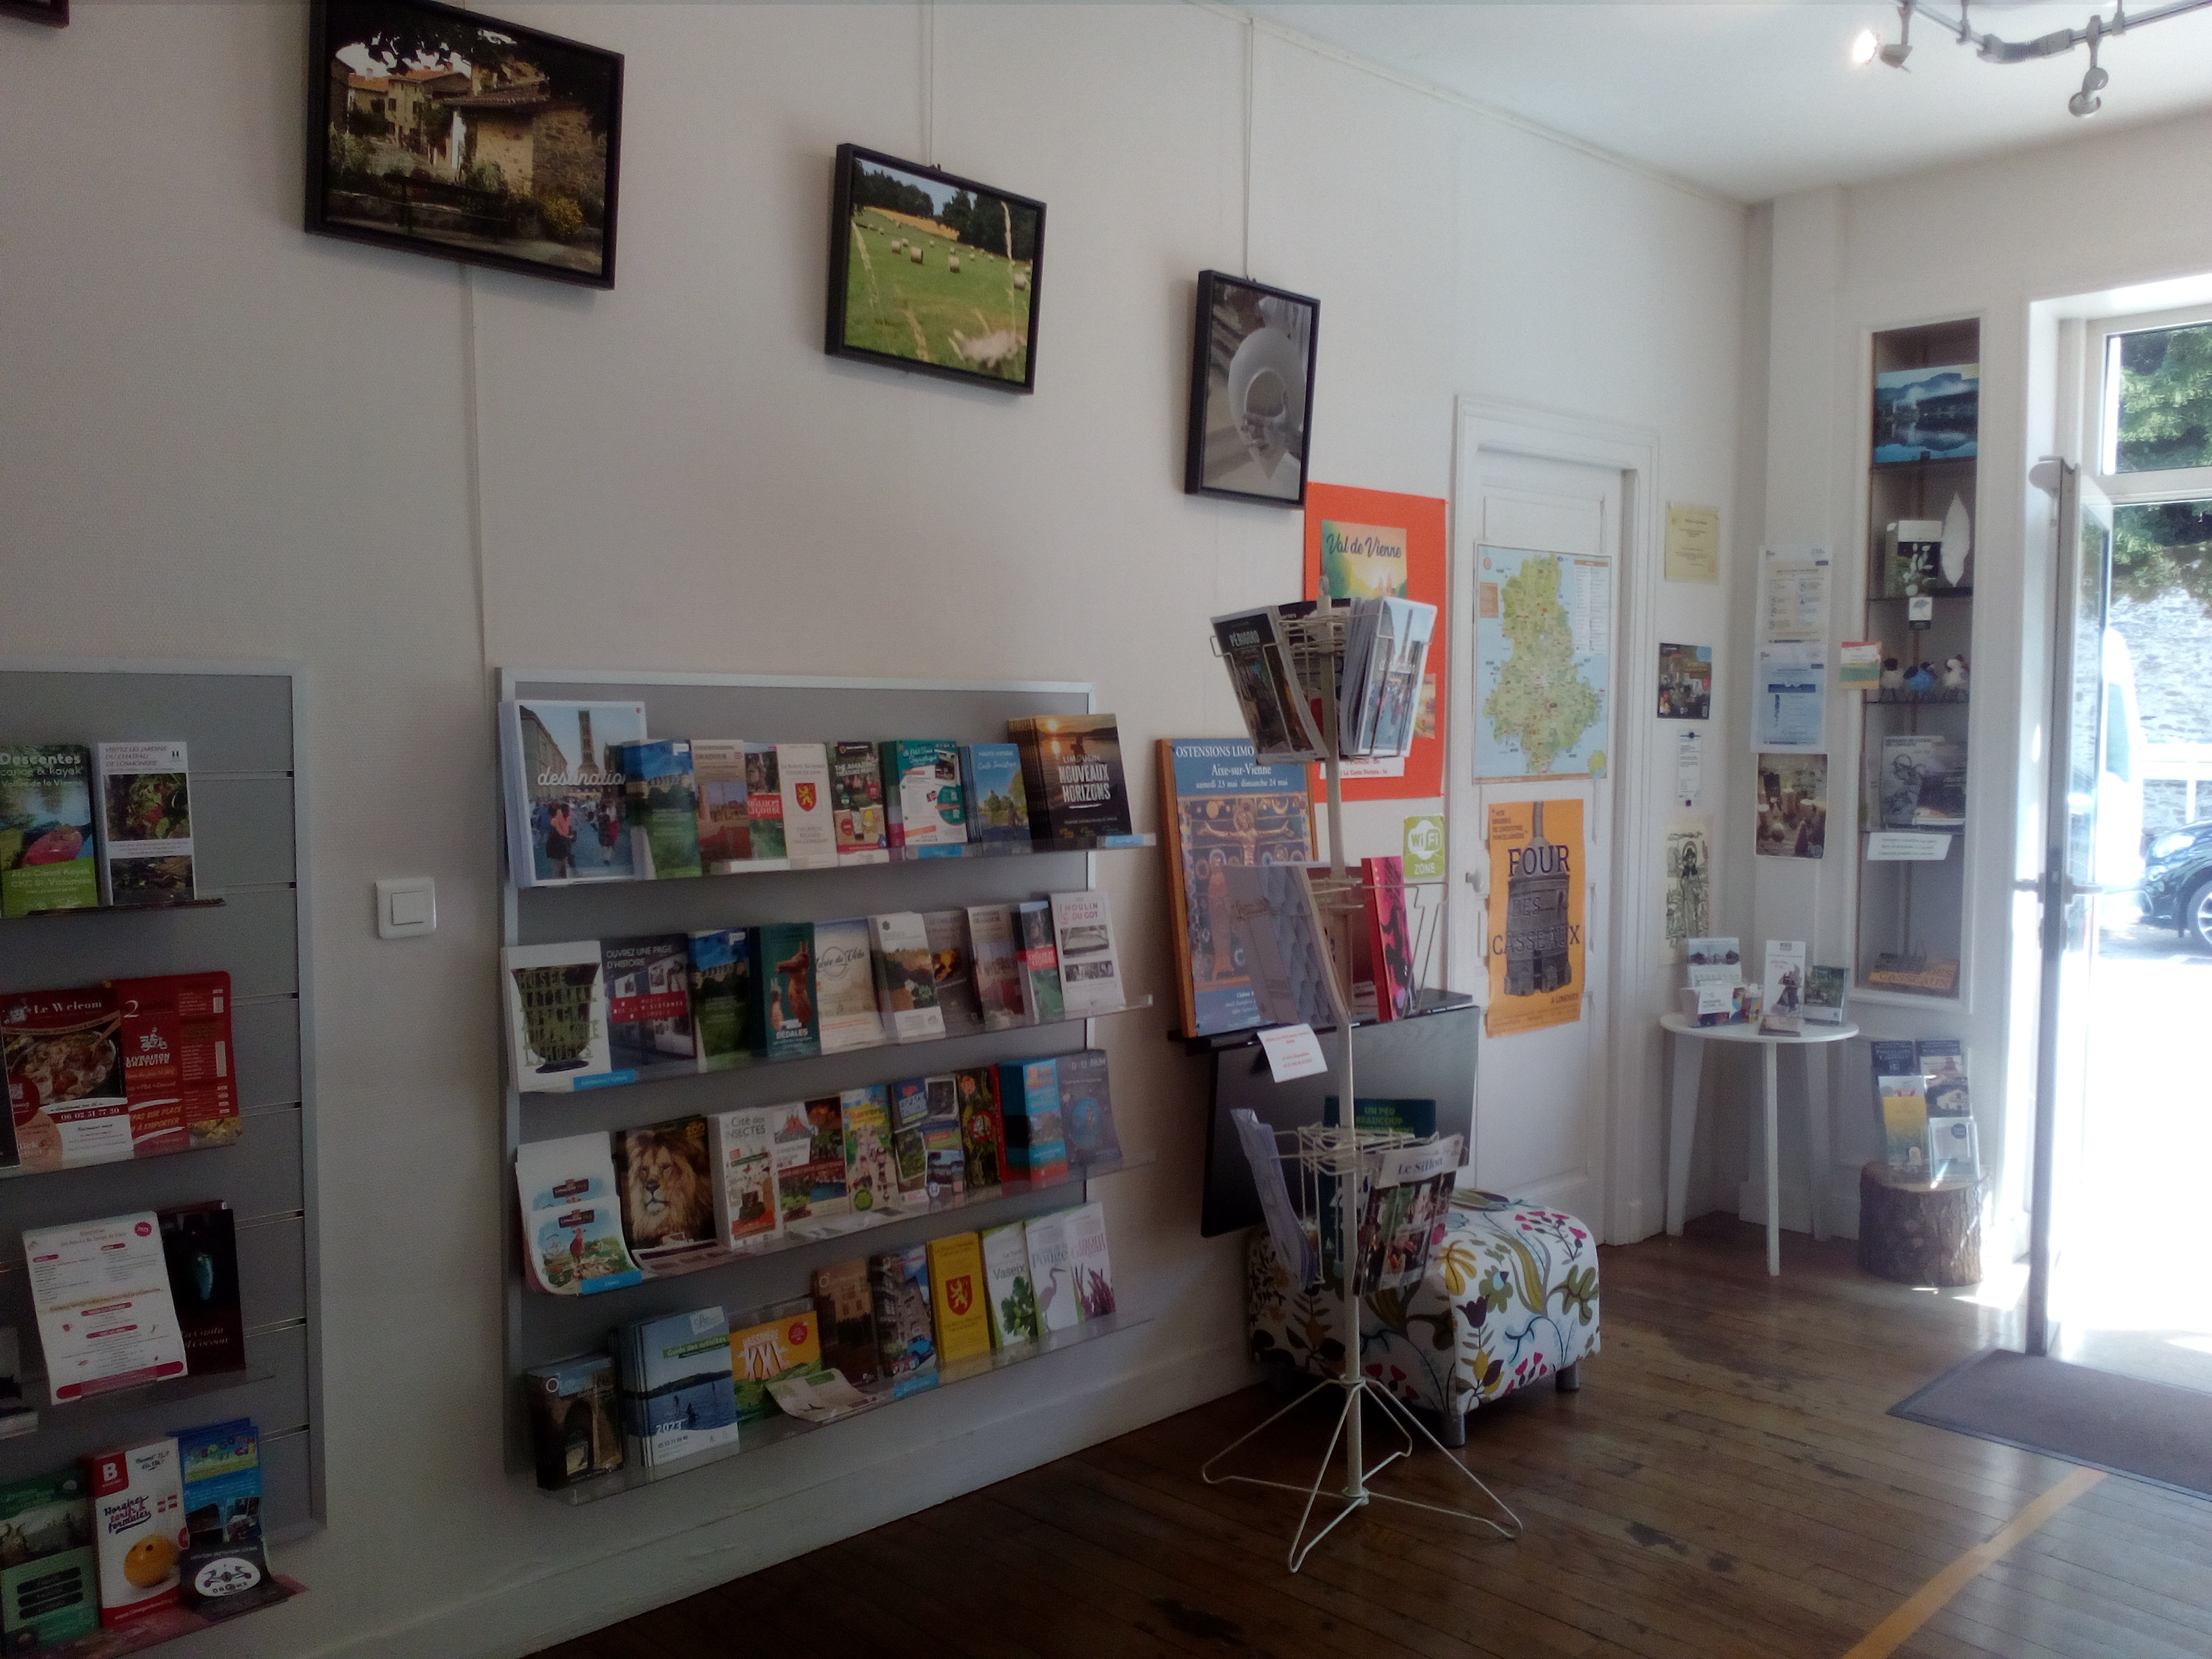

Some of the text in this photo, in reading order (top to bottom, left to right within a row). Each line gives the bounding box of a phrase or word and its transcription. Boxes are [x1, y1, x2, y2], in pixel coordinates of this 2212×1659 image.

[1326, 533, 1402, 558] Val de Vienne
[1176, 746, 1230, 758] OSTENSIONS
[0, 753, 81, 766] Descentes
[48, 766, 84, 780] kayak
[1057, 764, 1109, 784] NOUVEAUX
[1211, 763, 1271, 776] Aixe-sur-Vienne
[1195, 780, 1216, 789] samedi
[1240, 779, 1268, 787] dimanche
[1277, 778, 1288, 786] mai
[1061, 782, 1111, 802] HORIZONS
[1508, 844, 1571, 877] FOUR
[1414, 863, 1436, 875] ZONE
[1064, 903, 1099, 912] MOULIN
[1512, 897, 1540, 918] DES
[1072, 912, 1082, 920] DU
[1492, 924, 1580, 956] CASSEAUX
[607, 945, 674, 960] OUVREZ UNE PAGE
[35, 1001, 102, 1015] Le Welcom
[124, 1000, 140, 1018] 2
[126, 1052, 170, 1063] LIVRAISON
[126, 1057, 170, 1068] GRATUITE
[131, 1106, 182, 1122] PAS SUR PLACE
[1378, 1107, 1396, 1115] PEU
[1398, 1157, 1443, 1175] Le Sillon
[1032, 1251, 1068, 1269] Pouge
[993, 1265, 1025, 1281] Vaseix
[194, 1325, 224, 1338] Casita
[192, 1337, 229, 1349] Cocoon
[668, 1346, 686, 1357] Guide
[744, 1340, 791, 1382] XXL
[655, 1420, 682, 1433] 2023
[102, 1462, 119, 1482] B
